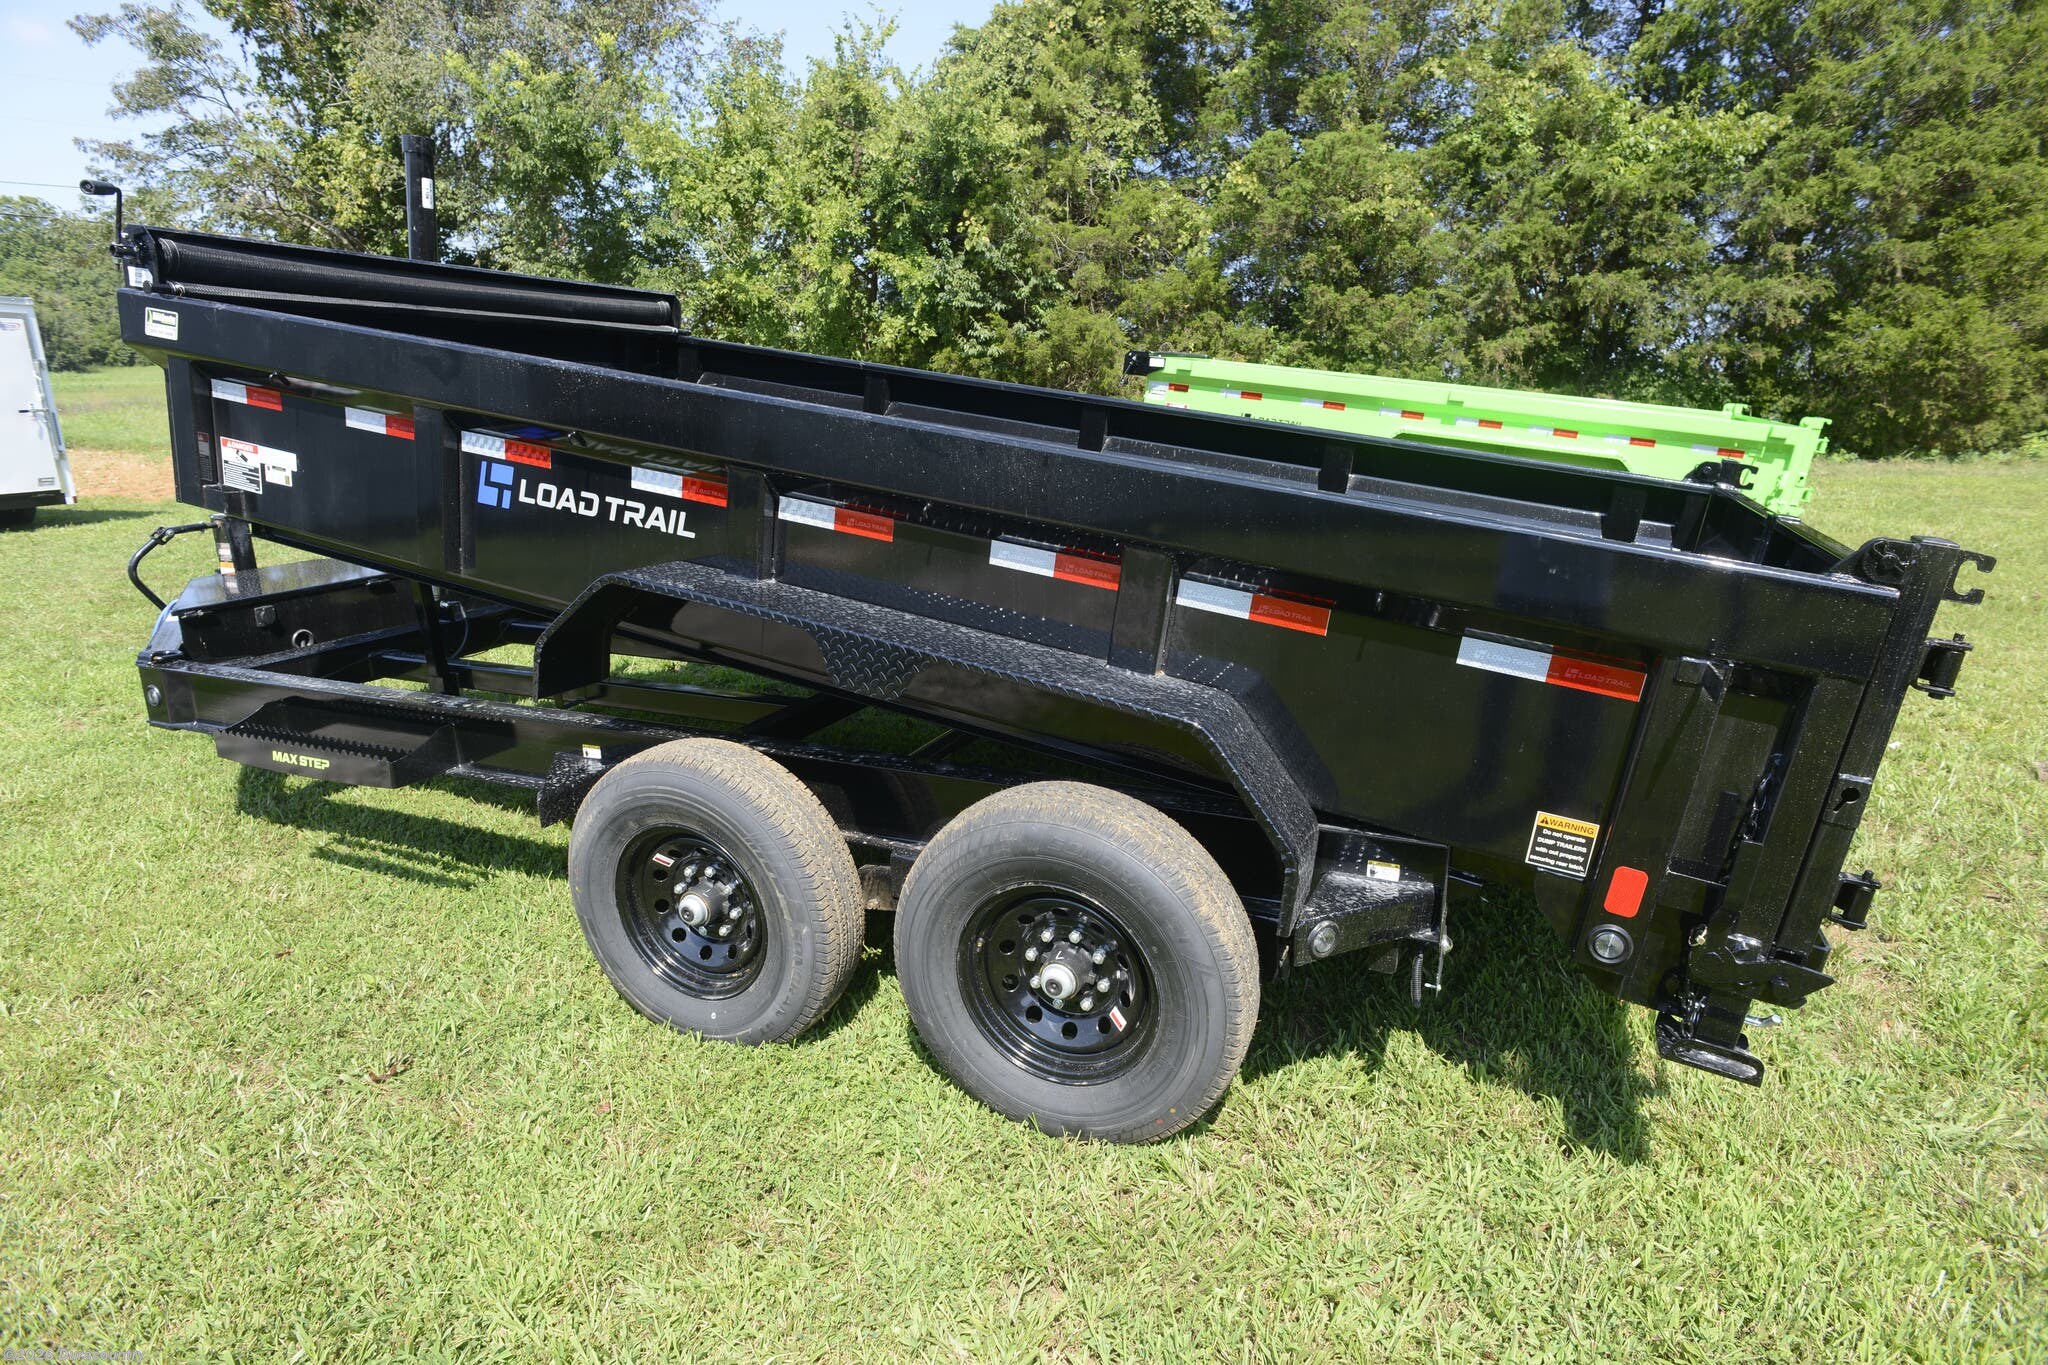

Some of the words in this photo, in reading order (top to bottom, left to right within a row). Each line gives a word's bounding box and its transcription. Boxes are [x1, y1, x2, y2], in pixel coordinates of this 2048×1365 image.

[518, 479, 600, 518] LOAD
[605, 496, 696, 539] TRAIL
[1578, 672, 1605, 683] LOAD
[1605, 677, 1632, 689] TRAIL
[272, 750, 298, 765] MAX
[299, 755, 330, 770] STEP
[1549, 819, 1594, 836] WARNING
[1537, 836, 1556, 845] DUMP
[1556, 841, 1587, 853] TRAILERS
[1563, 833, 1585, 843] operate
[1530, 854, 1555, 865] securing
[1556, 860, 1568, 868] rear
